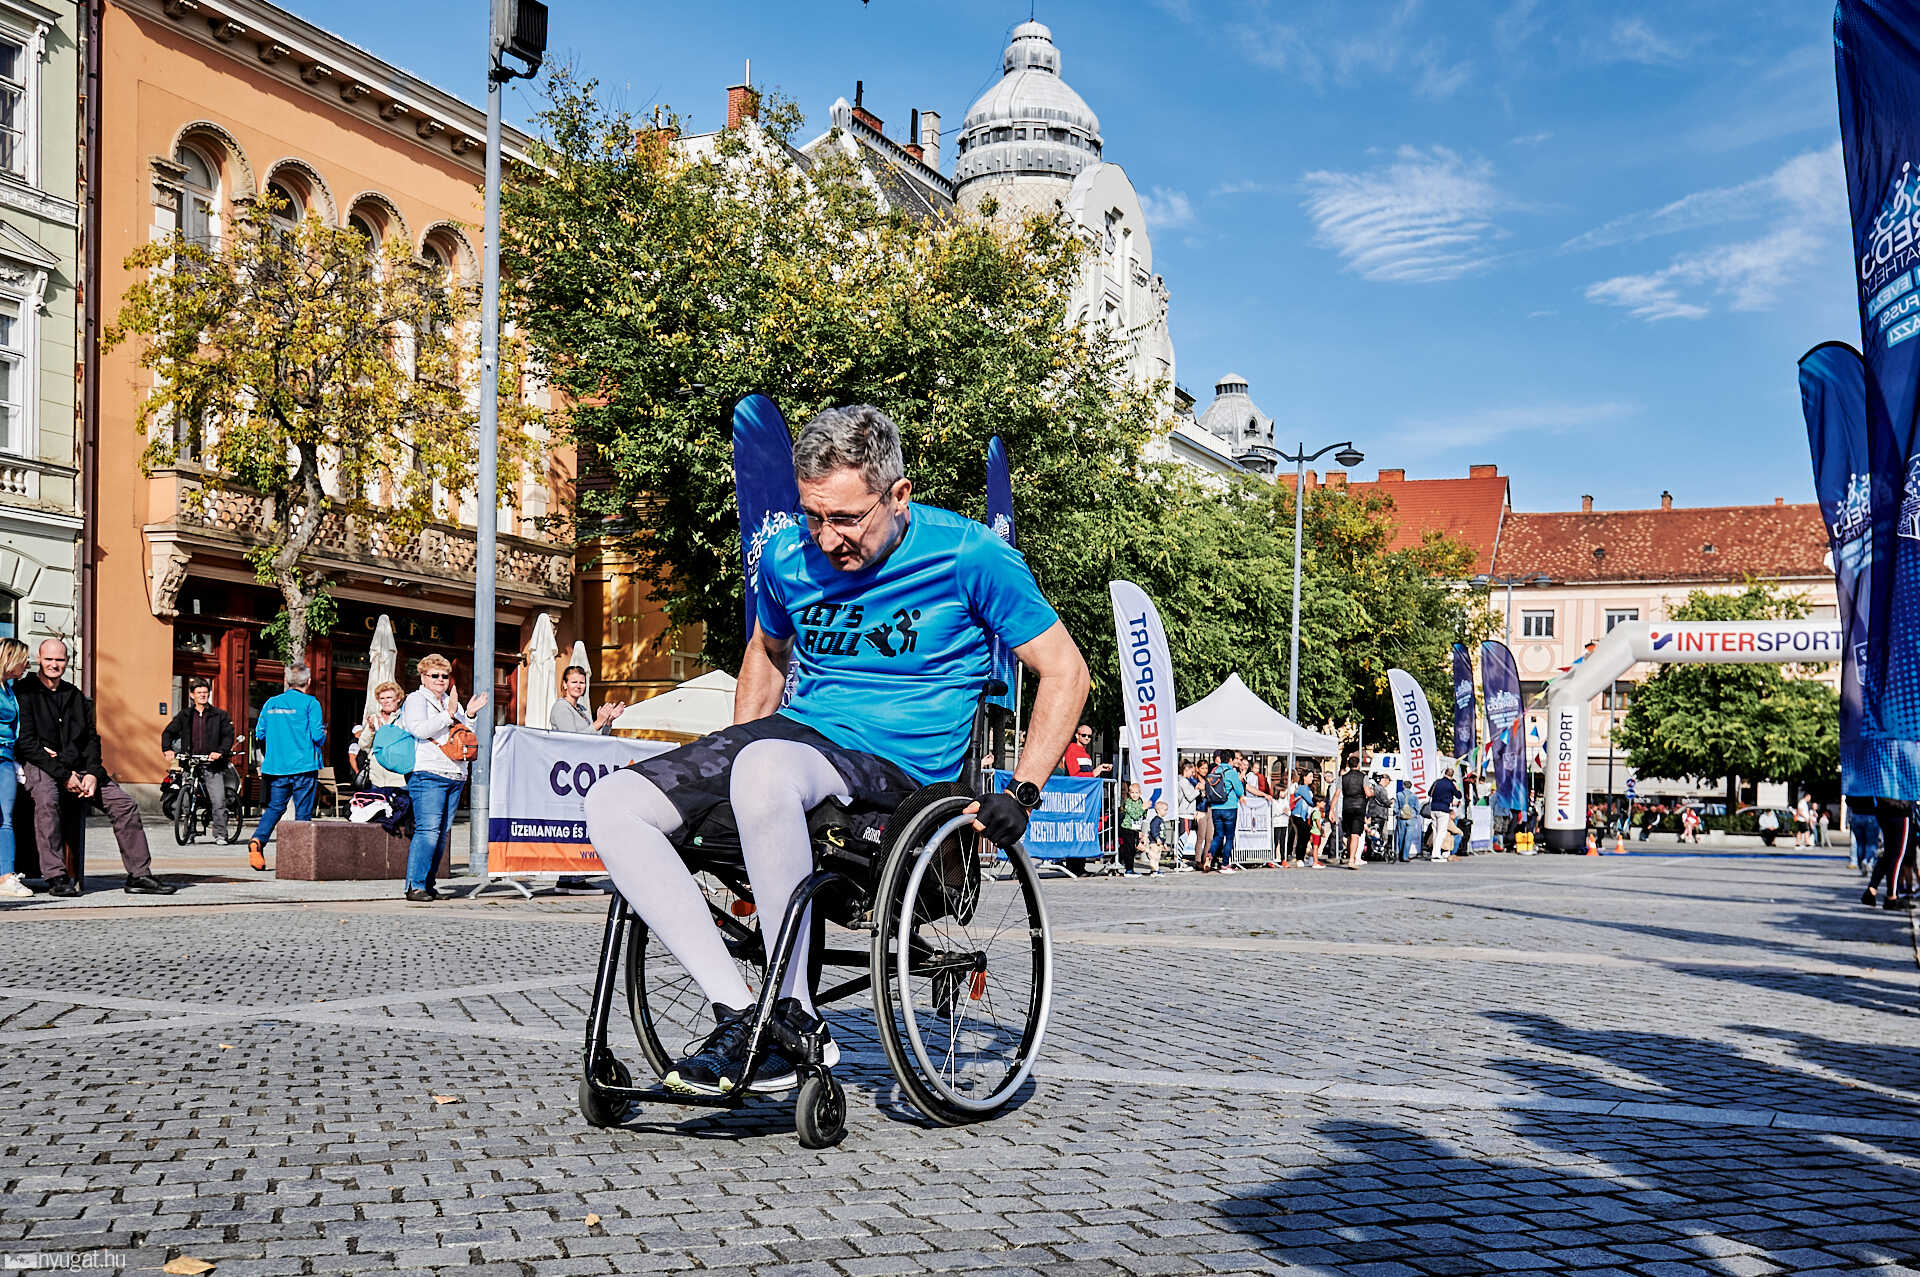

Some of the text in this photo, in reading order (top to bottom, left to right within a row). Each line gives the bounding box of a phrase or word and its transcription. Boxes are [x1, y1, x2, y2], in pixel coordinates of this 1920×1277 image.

[798, 603, 865, 628] LET'S
[805, 629, 863, 656] ROLL
[1677, 630, 1843, 652] INTERSPORT
[1557, 711, 1576, 806] INTERSPORT
[1040, 791, 1088, 813] SZOMBATHELY
[511, 822, 570, 838] ÜZEMANYAG
[573, 824, 583, 838] ÉS
[1029, 819, 1096, 843] MEGYEI JOGÚ VÁROS
